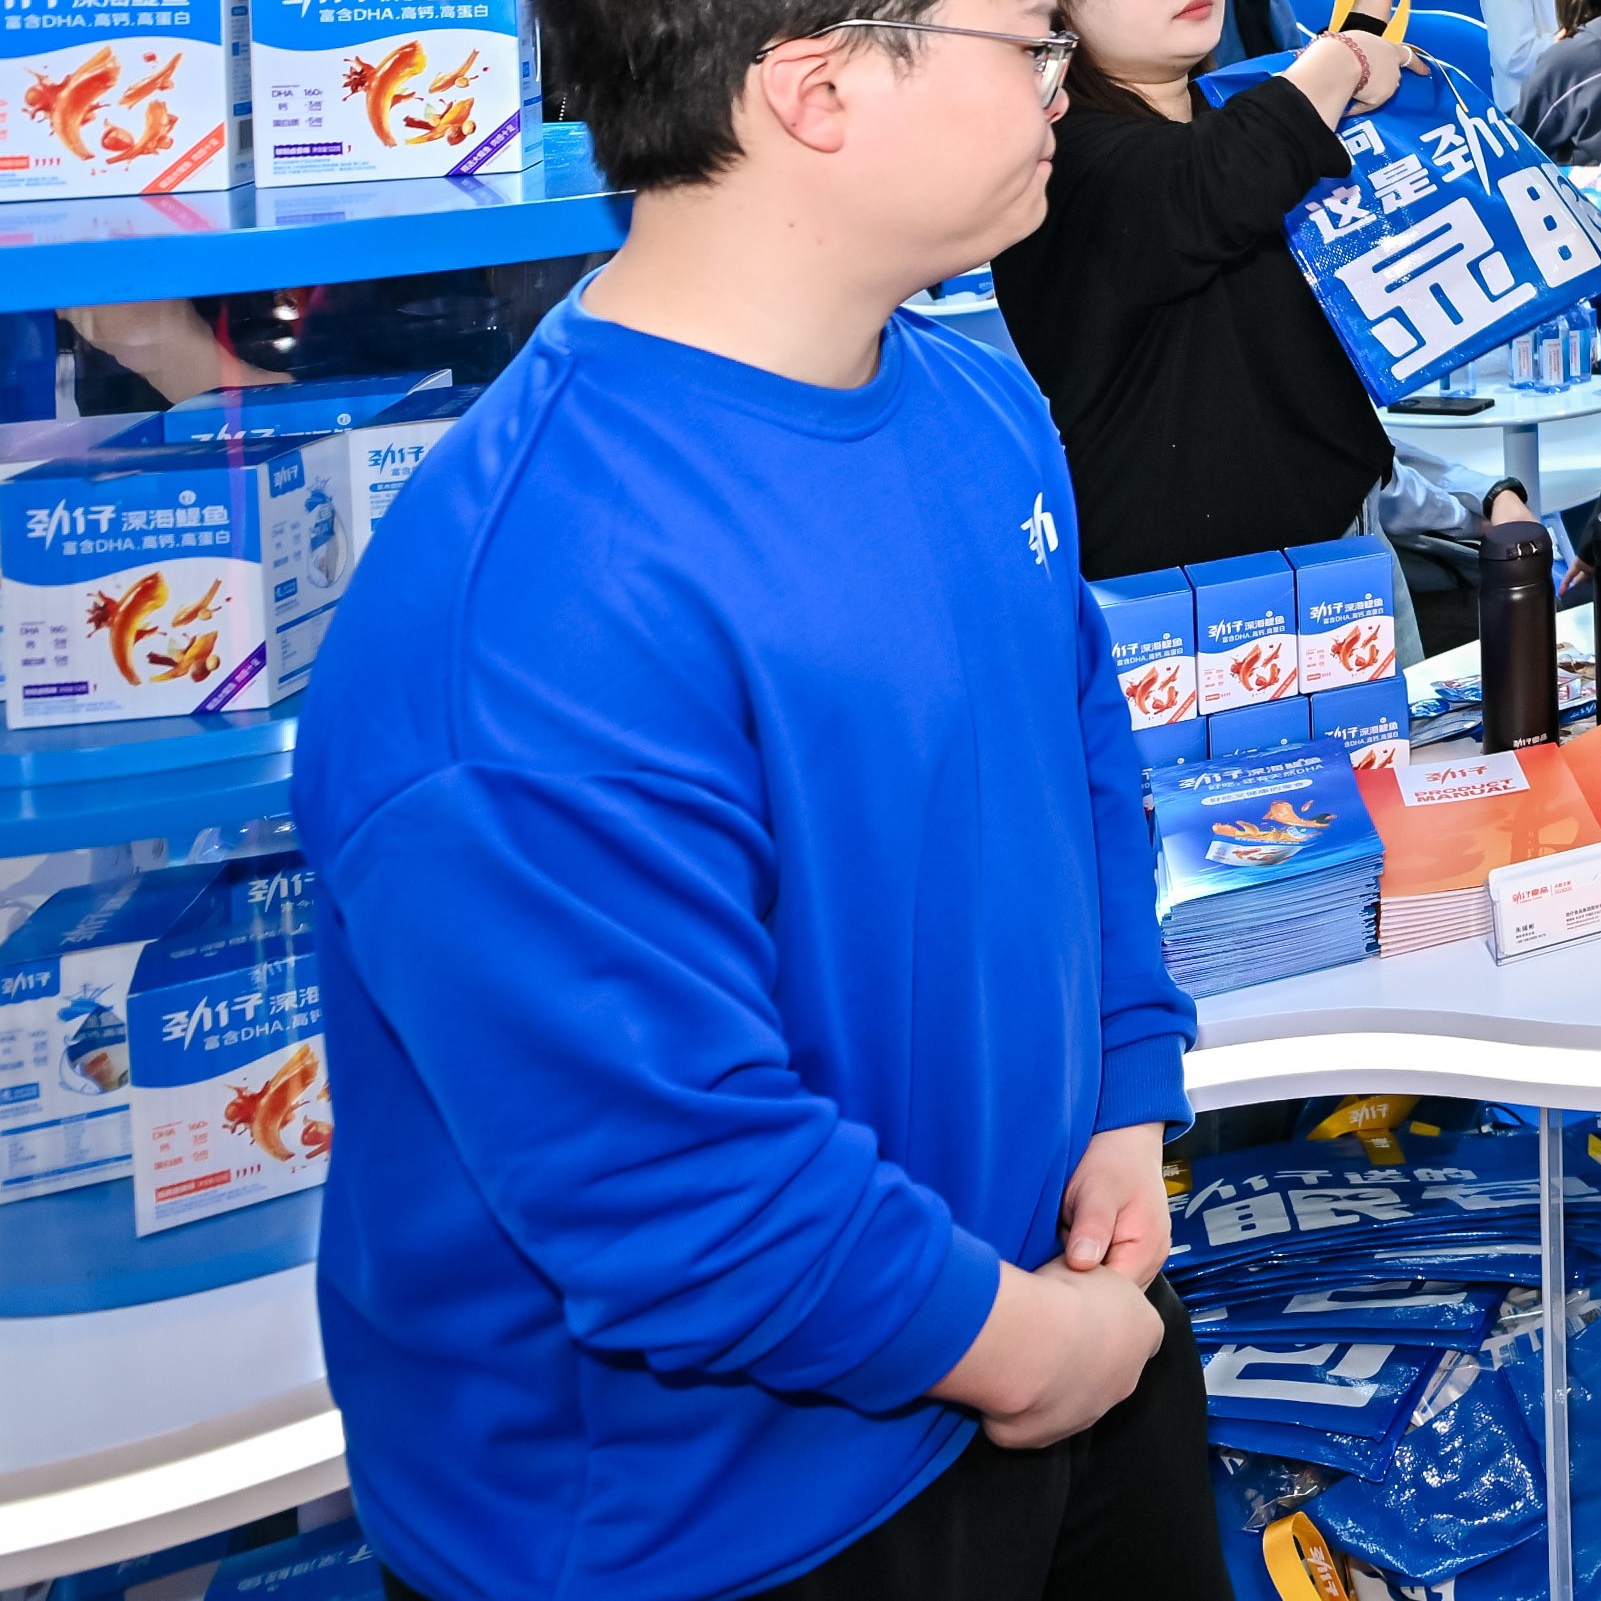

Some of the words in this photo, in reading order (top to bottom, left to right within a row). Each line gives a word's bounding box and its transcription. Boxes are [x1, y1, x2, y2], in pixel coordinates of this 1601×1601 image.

[1425, 765, 1488, 785] 劲仔
[1414, 778, 1513, 797] PRODUCT
[1416, 784, 1518, 803] MANUAL
[162, 996, 263, 1050] 劲仔
